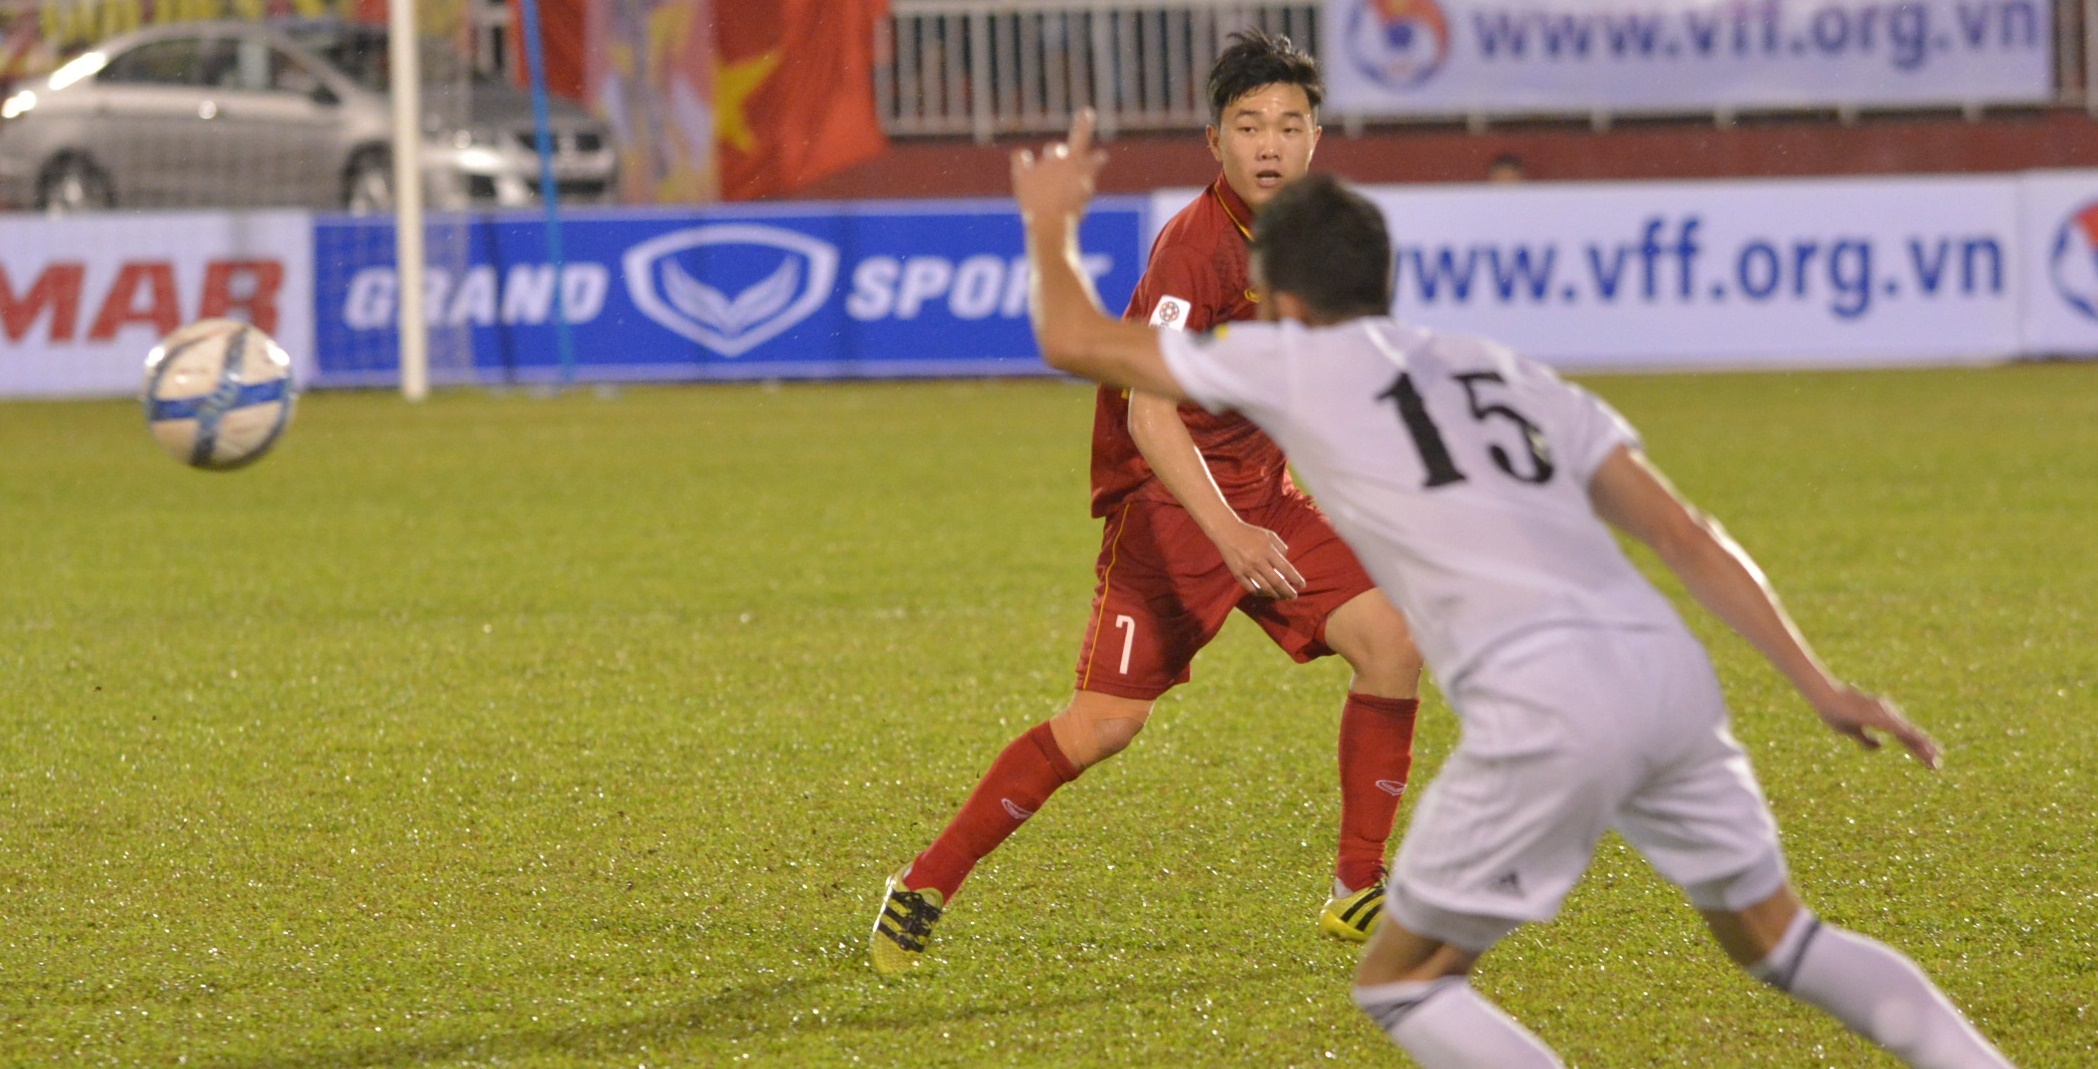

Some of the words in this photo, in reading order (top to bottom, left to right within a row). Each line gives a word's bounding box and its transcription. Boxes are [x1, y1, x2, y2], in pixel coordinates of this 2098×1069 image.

[1392, 219, 2003, 320] ww.vff.org.vn
[1374, 371, 1555, 488] 15
[1115, 614, 1135, 675] 7
